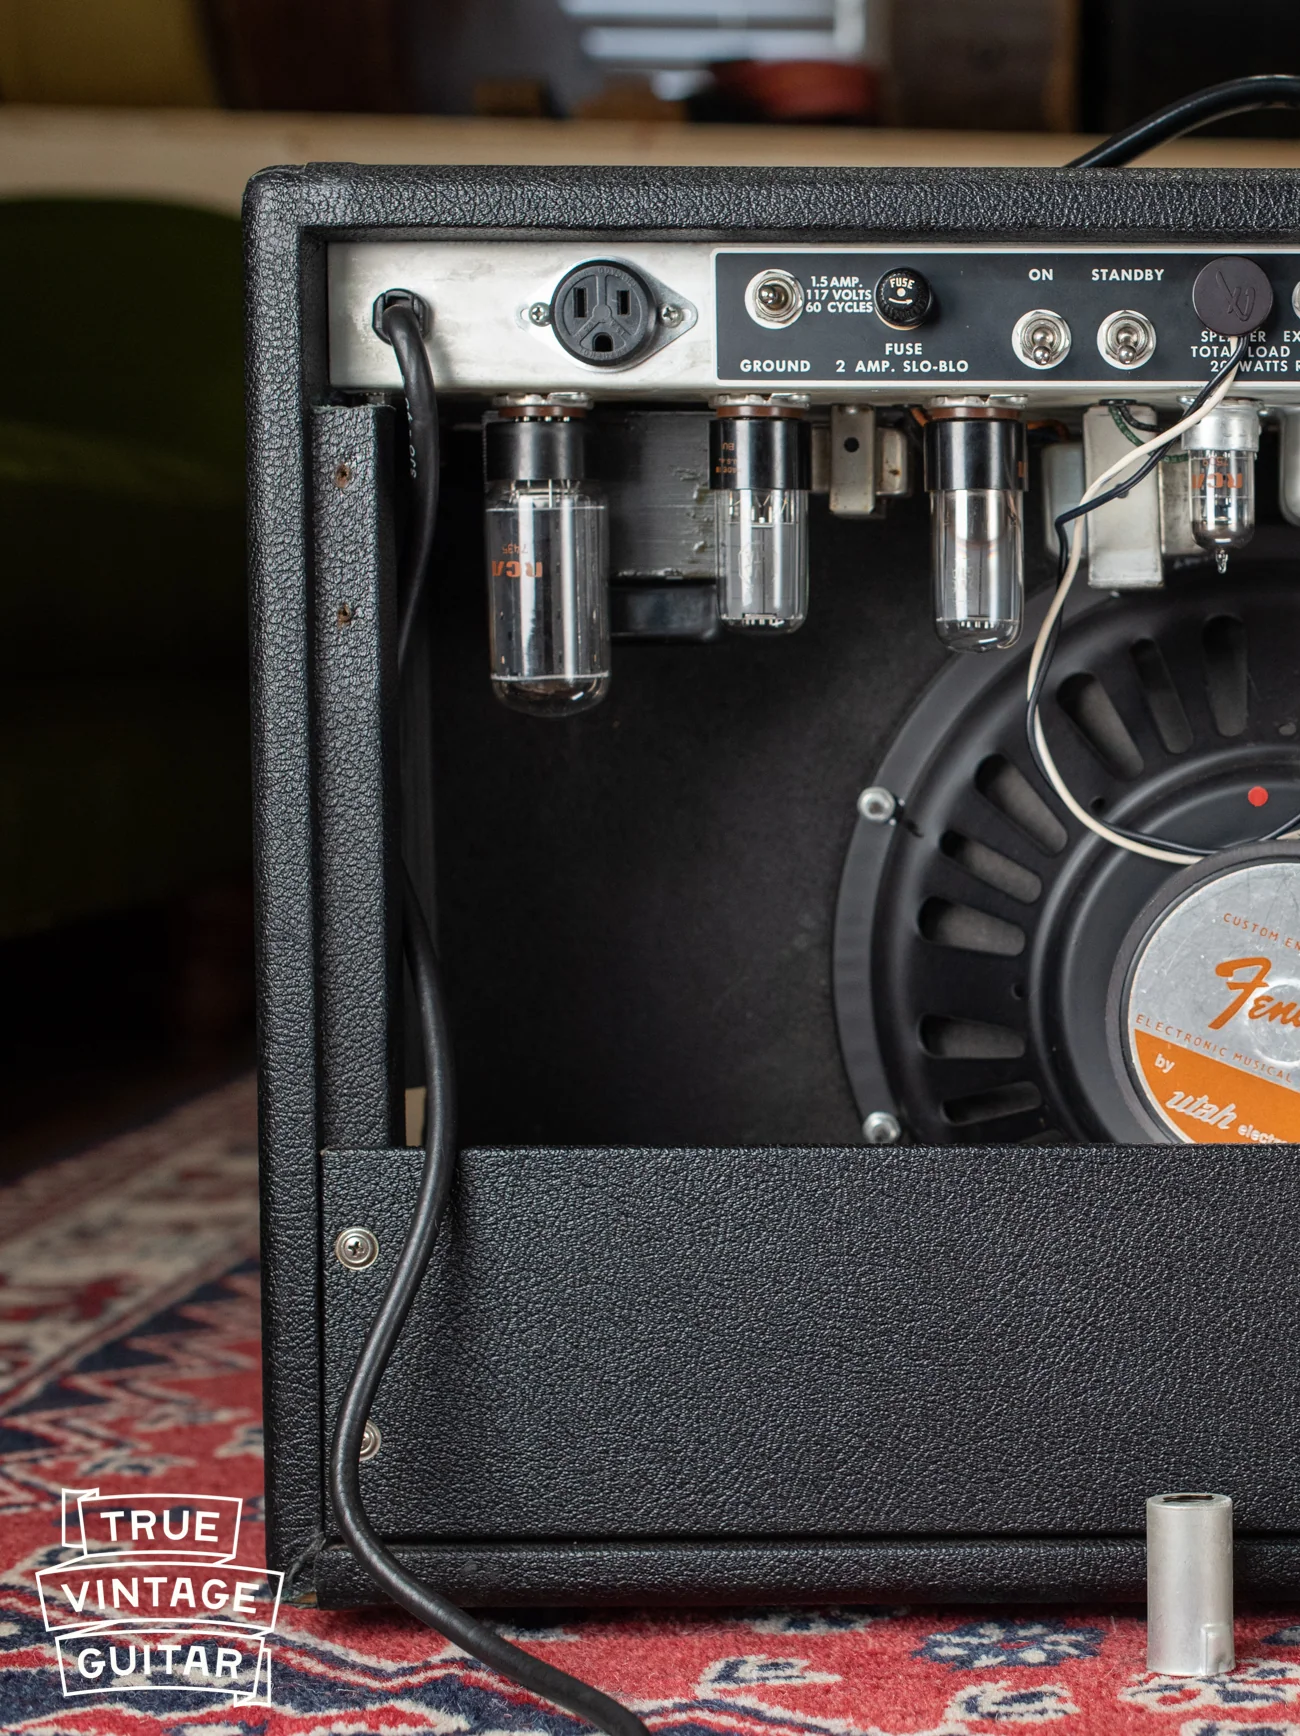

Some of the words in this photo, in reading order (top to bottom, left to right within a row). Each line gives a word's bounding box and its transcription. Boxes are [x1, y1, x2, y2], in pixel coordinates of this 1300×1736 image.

[810, 275, 829, 288] 1.5
[829, 275, 864, 288] AMP.
[1028, 268, 1054, 282] ON
[1091, 268, 1165, 282] STANDBY
[889, 277, 916, 290] FUSE
[806, 288, 830, 301] 117
[831, 288, 873, 301] VOLTS
[805, 301, 822, 314] 60
[827, 301, 874, 314] CYCLES
[1200, 330, 1267, 343] SPEER
[884, 342, 923, 356] FUSE
[1191, 346, 1235, 358] TOTA
[1248, 345, 1291, 358] LOAD
[739, 359, 811, 373] GROUND
[835, 359, 846, 373] 2
[854, 359, 896, 373] AMP.
[902, 359, 969, 373] SLO-BLO
[1239, 360, 1288, 373] WATTS
[491, 560, 543, 578] RCA
[1222, 912, 1279, 942] CUSTOM
[1135, 1013, 1228, 1057] ELECTRONIC
[1232, 1052, 1292, 1083] MUSICAL
[1154, 1053, 1175, 1074] by
[1164, 1091, 1238, 1130] utah
